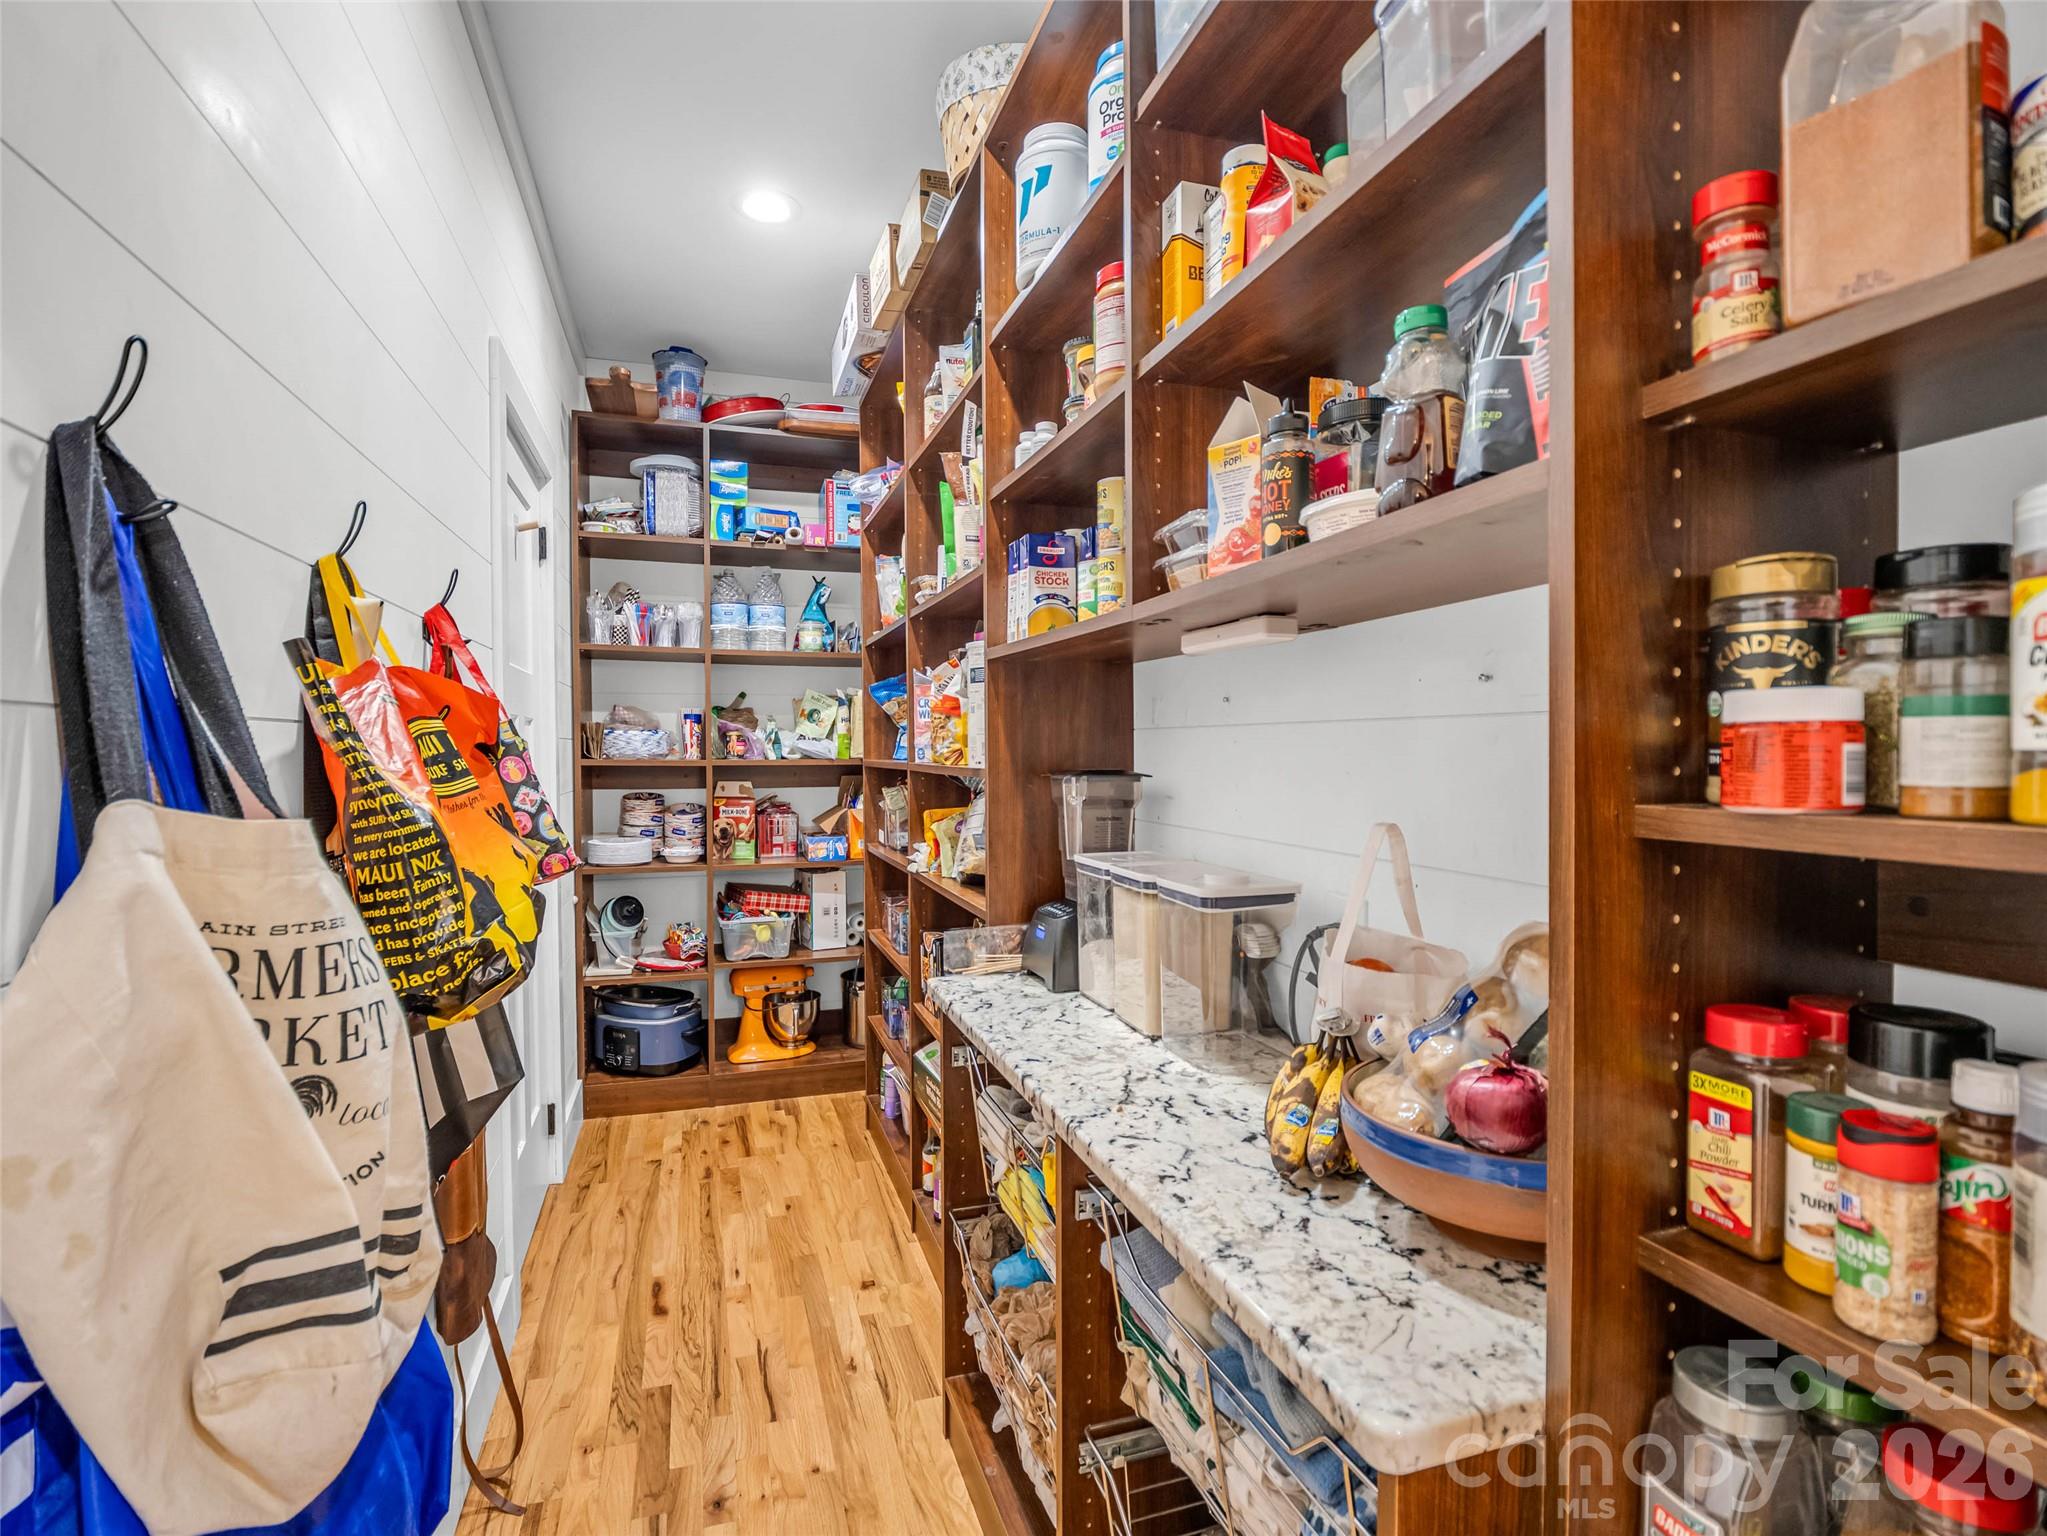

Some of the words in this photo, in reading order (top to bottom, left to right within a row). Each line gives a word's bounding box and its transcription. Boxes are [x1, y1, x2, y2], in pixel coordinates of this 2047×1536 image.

[862, 277, 870, 323] CIRCULON
[1720, 300, 1767, 319] Celery
[1729, 312, 1759, 329] Salt
[1034, 577, 1070, 586] STOCK
[1036, 570, 1067, 578] CHICKEN
[1715, 633, 1821, 672] KINDER'S
[721, 808, 748, 816] MILK-BONE
[350, 816, 369, 829] with
[353, 834, 362, 844] in
[363, 832, 383, 843] every
[353, 849, 368, 862] we
[369, 847, 386, 859] are
[388, 831, 440, 854] located.
[355, 862, 406, 886] MAUI
[409, 849, 445, 877] NIX
[359, 890, 374, 903] has
[375, 884, 410, 901] been
[413, 870, 452, 895] family
[389, 902, 411, 916] and
[414, 885, 460, 911] operated
[394, 900, 466, 933] inception
[385, 937, 409, 951] has
[415, 951, 426, 963] &
[1692, 1073, 1707, 1090] 3X
[1707, 1080, 1747, 1099] MORE
[1707, 1142, 1732, 1157] Chili
[1699, 1150, 1740, 1168] Powder
[343, 1151, 385, 1186] ION
